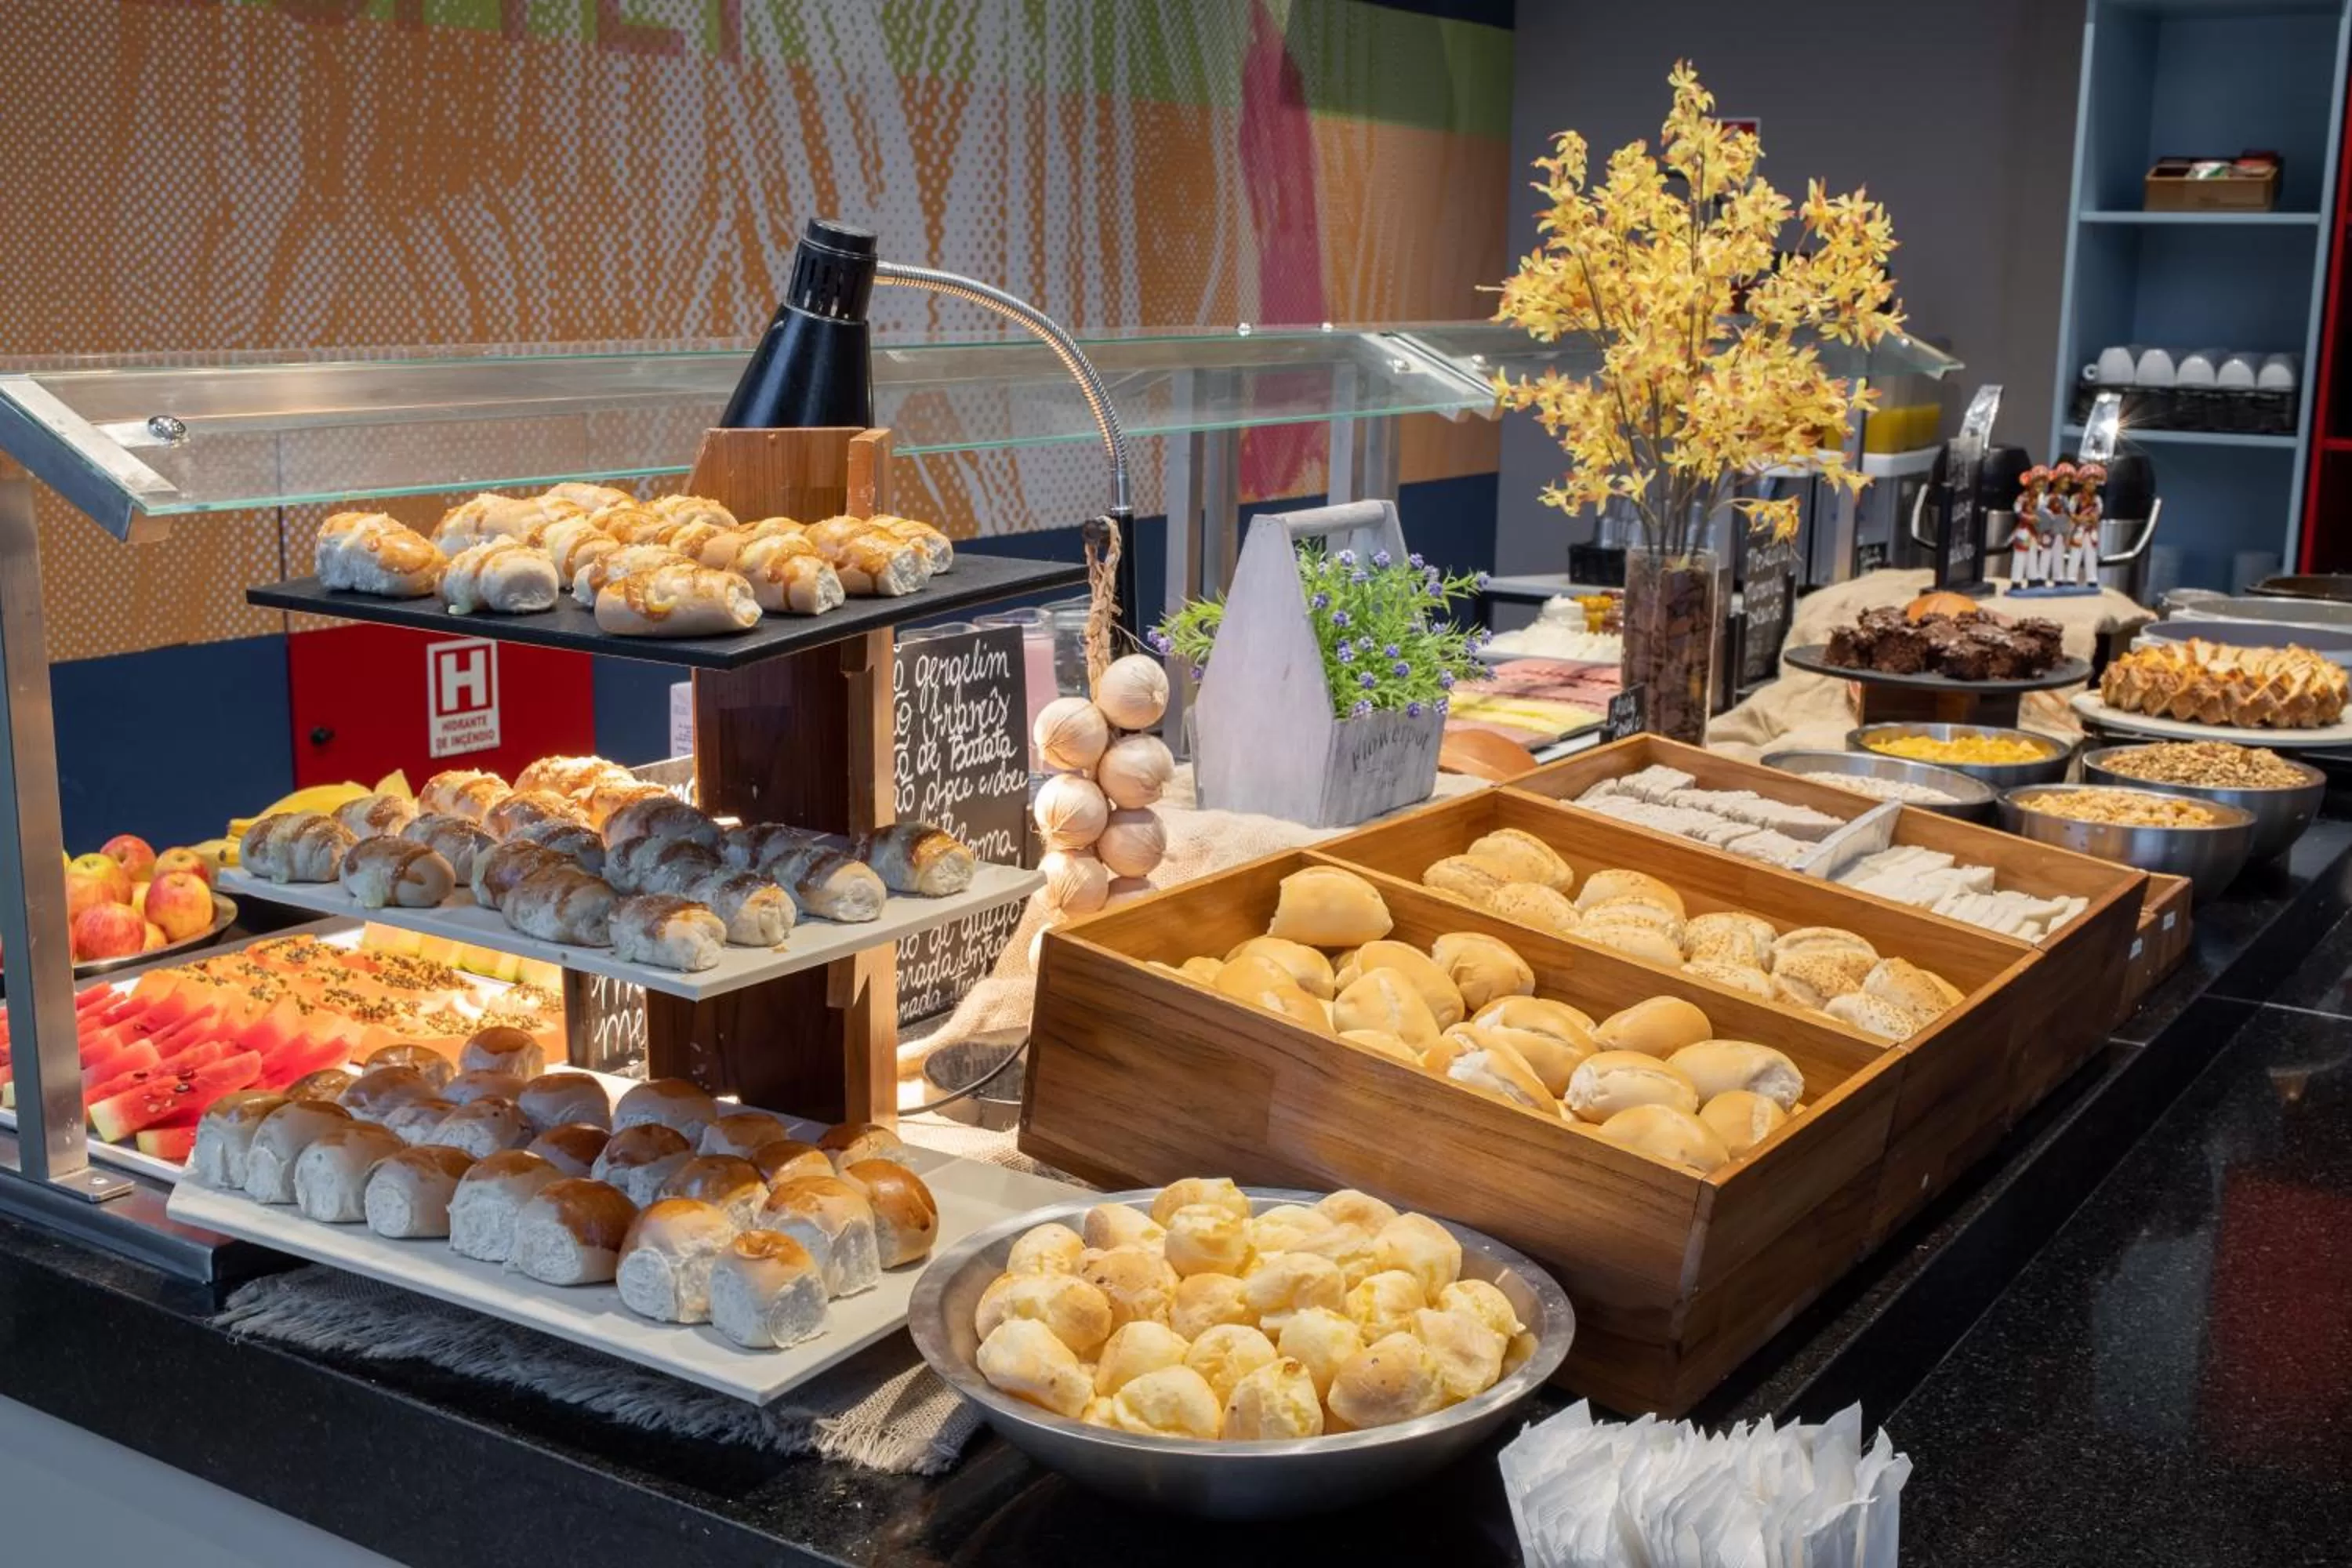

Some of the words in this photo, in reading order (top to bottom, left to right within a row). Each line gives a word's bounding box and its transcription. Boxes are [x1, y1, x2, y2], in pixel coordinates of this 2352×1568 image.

[440, 649, 488, 712] H
[916, 638, 1010, 714] gergelim
[435, 735, 448, 750] DE
[441, 715, 488, 731] HIDRANTE
